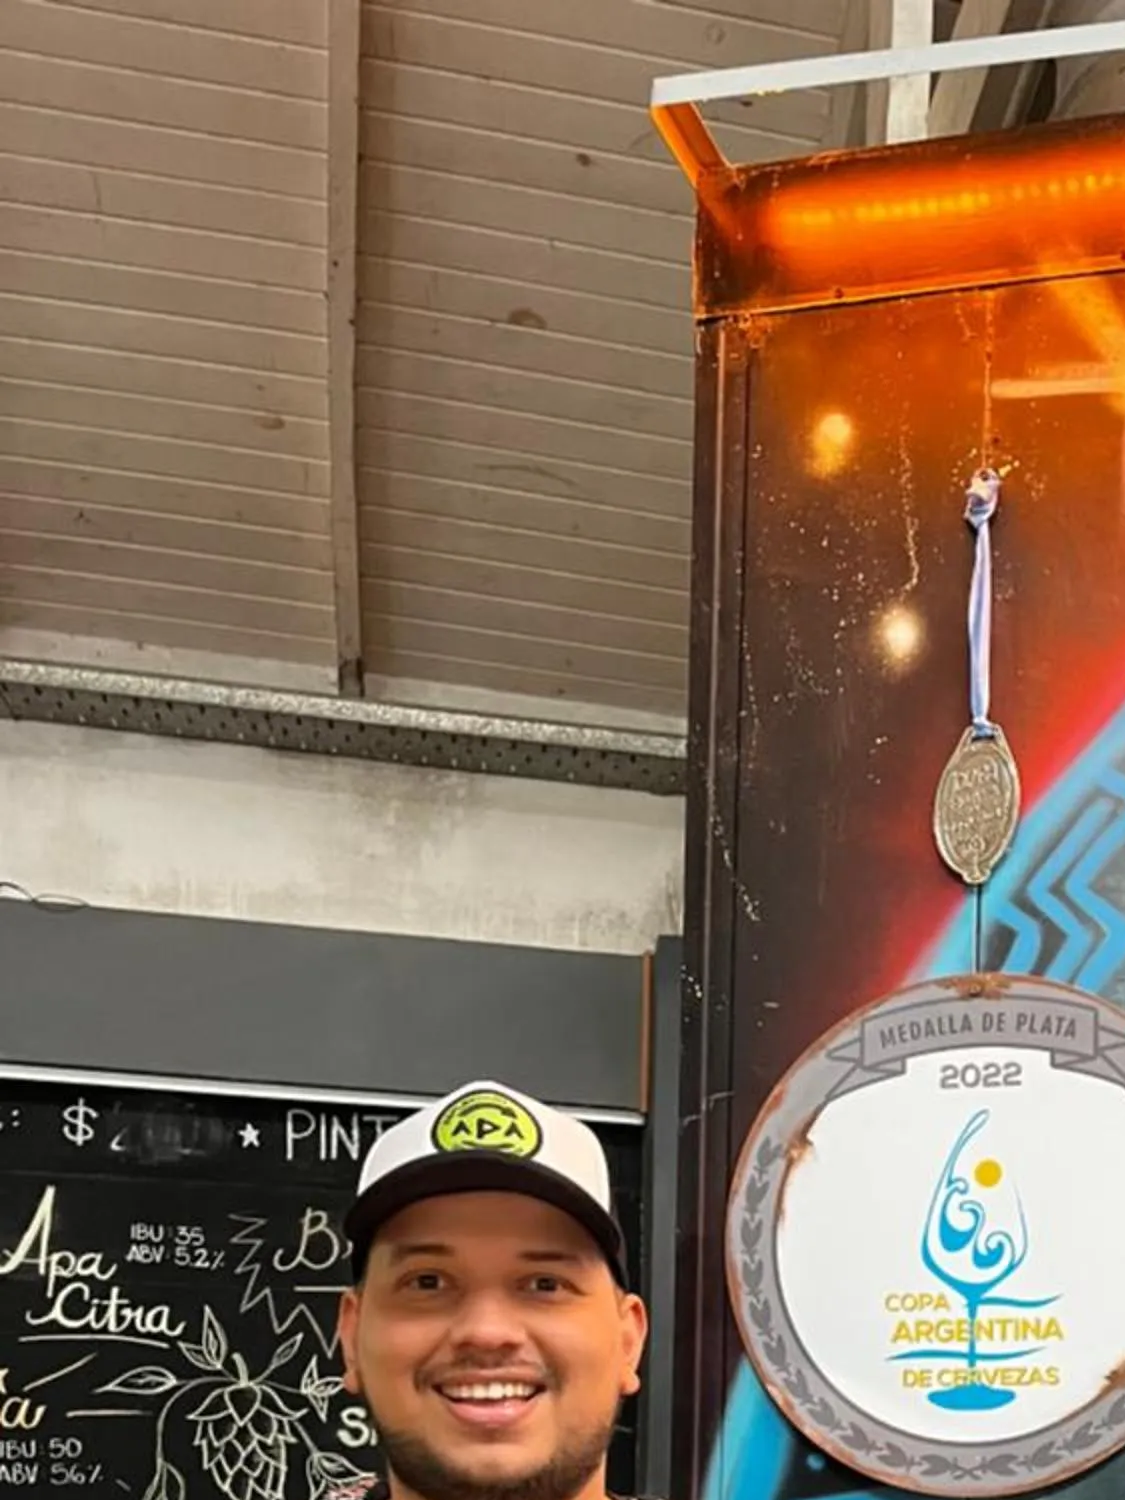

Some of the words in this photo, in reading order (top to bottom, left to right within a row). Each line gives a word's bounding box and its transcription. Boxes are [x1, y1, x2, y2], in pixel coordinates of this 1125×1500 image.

[879, 1013, 973, 1049] MEDALLA
[982, 1012, 1006, 1032] DE
[1015, 1013, 1077, 1039] PLATA
[940, 1062, 1023, 1089] 2022
[452, 1118, 525, 1139] APA
[0, 1185, 118, 1298] Apa
[25, 1282, 186, 1338] Citra
[884, 1293, 951, 1312] COPA
[891, 1316, 1065, 1344] ARGENTINA
[903, 1368, 933, 1388] DE
